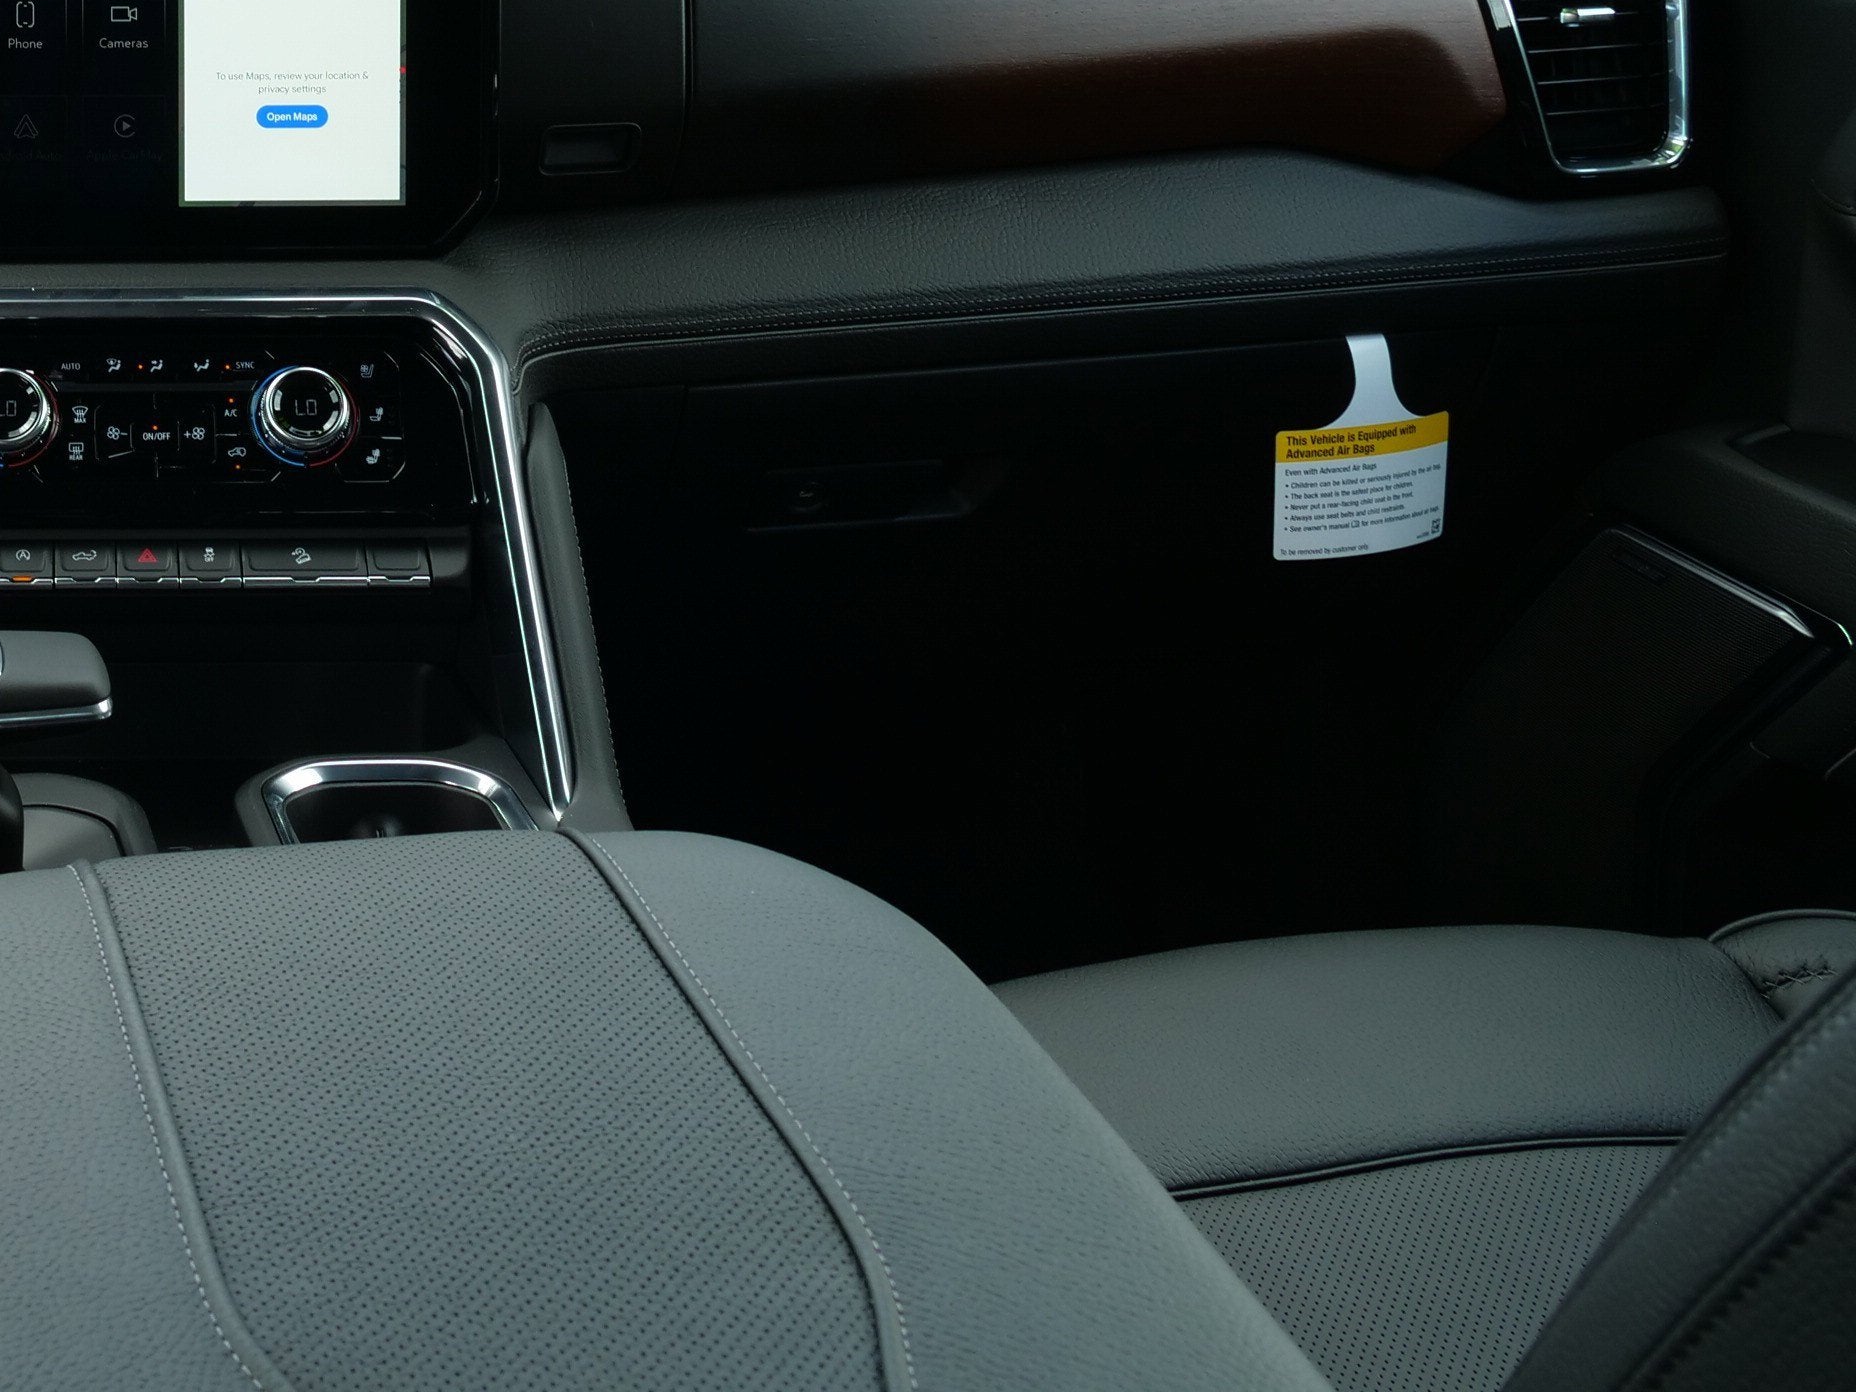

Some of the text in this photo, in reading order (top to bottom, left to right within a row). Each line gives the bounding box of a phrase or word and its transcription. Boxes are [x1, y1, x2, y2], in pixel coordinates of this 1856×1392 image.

[7, 37, 44, 50] Phone
[99, 37, 149, 49] Cameras
[216, 71, 369, 83] To use Maps, review your location &
[258, 84, 327, 96] privacy settings
[266, 112, 318, 124] Open Maps
[61, 362, 82, 371] AUTO
[235, 361, 255, 370] SYNC
[224, 408, 239, 418] A/C
[294, 399, 318, 417] LO
[73, 417, 88, 425] MAX
[142, 431, 172, 442] ON/OFF
[1287, 424, 1417, 447] This Vehicle is Equipped with
[70, 452, 84, 461] REAR
[1286, 443, 1375, 459] Advanced Air Bags
[1285, 463, 1377, 477] Even with Advanced Air Bags
[1290, 481, 1318, 490] Children
[1319, 480, 1331, 488] can
[1332, 479, 1340, 487] be
[1342, 477, 1358, 486] killed
[1304, 491, 1319, 499] back
[1341, 488, 1351, 496] the
[1290, 502, 1309, 511] Never
[1310, 502, 1321, 511] put
[1327, 500, 1359, 510] rear-facing
[1360, 498, 1373, 506] child
[1290, 507, 1380, 523] Always use seat belts and child
[1289, 524, 1302, 533] See
[1303, 524, 1327, 532] owner's
[1329, 521, 1350, 530] manual
[1361, 519, 1369, 527] for
[1280, 544, 1357, 557] To be removed by customer
